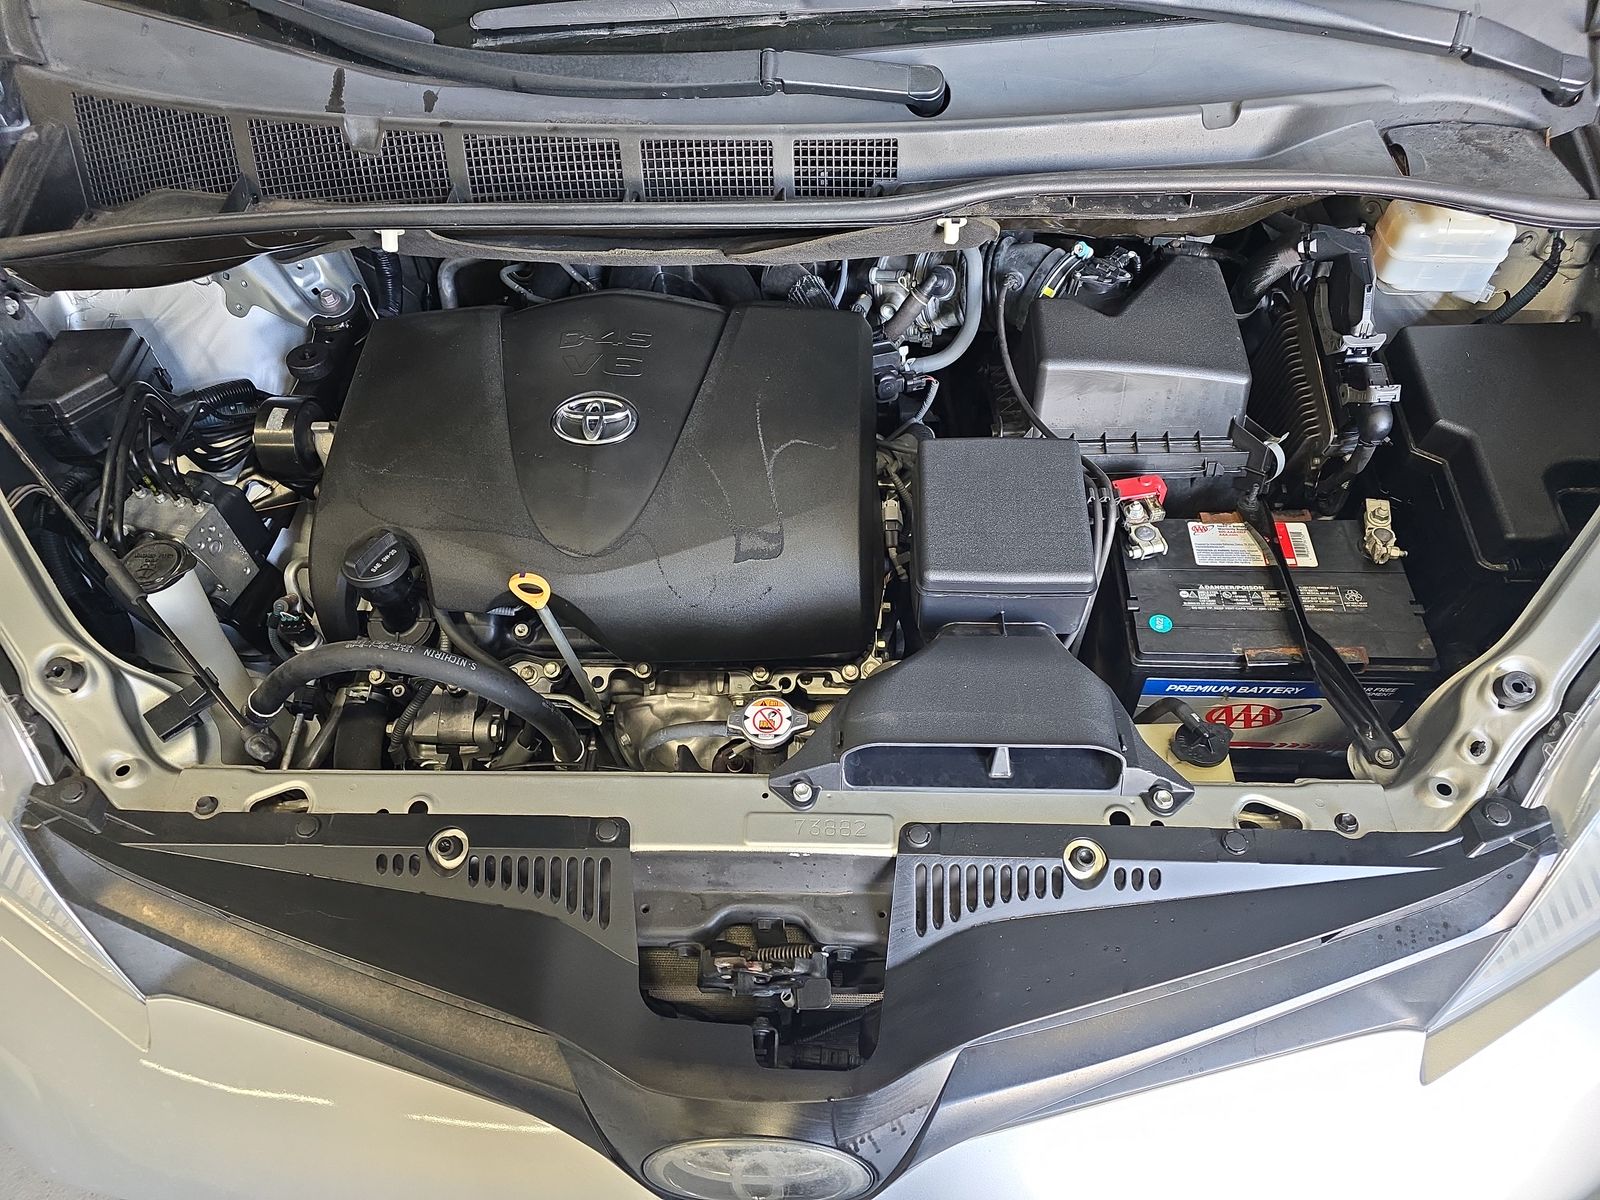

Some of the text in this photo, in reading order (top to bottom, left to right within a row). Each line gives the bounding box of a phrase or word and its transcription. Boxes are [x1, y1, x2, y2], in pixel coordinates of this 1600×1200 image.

[562, 353, 643, 377] V6
[370, 562, 383, 573] SAE
[1165, 684, 1305, 695] PREMIUM BATTERY
[1206, 703, 1282, 729] AAA
[795, 818, 867, 838] 73882
